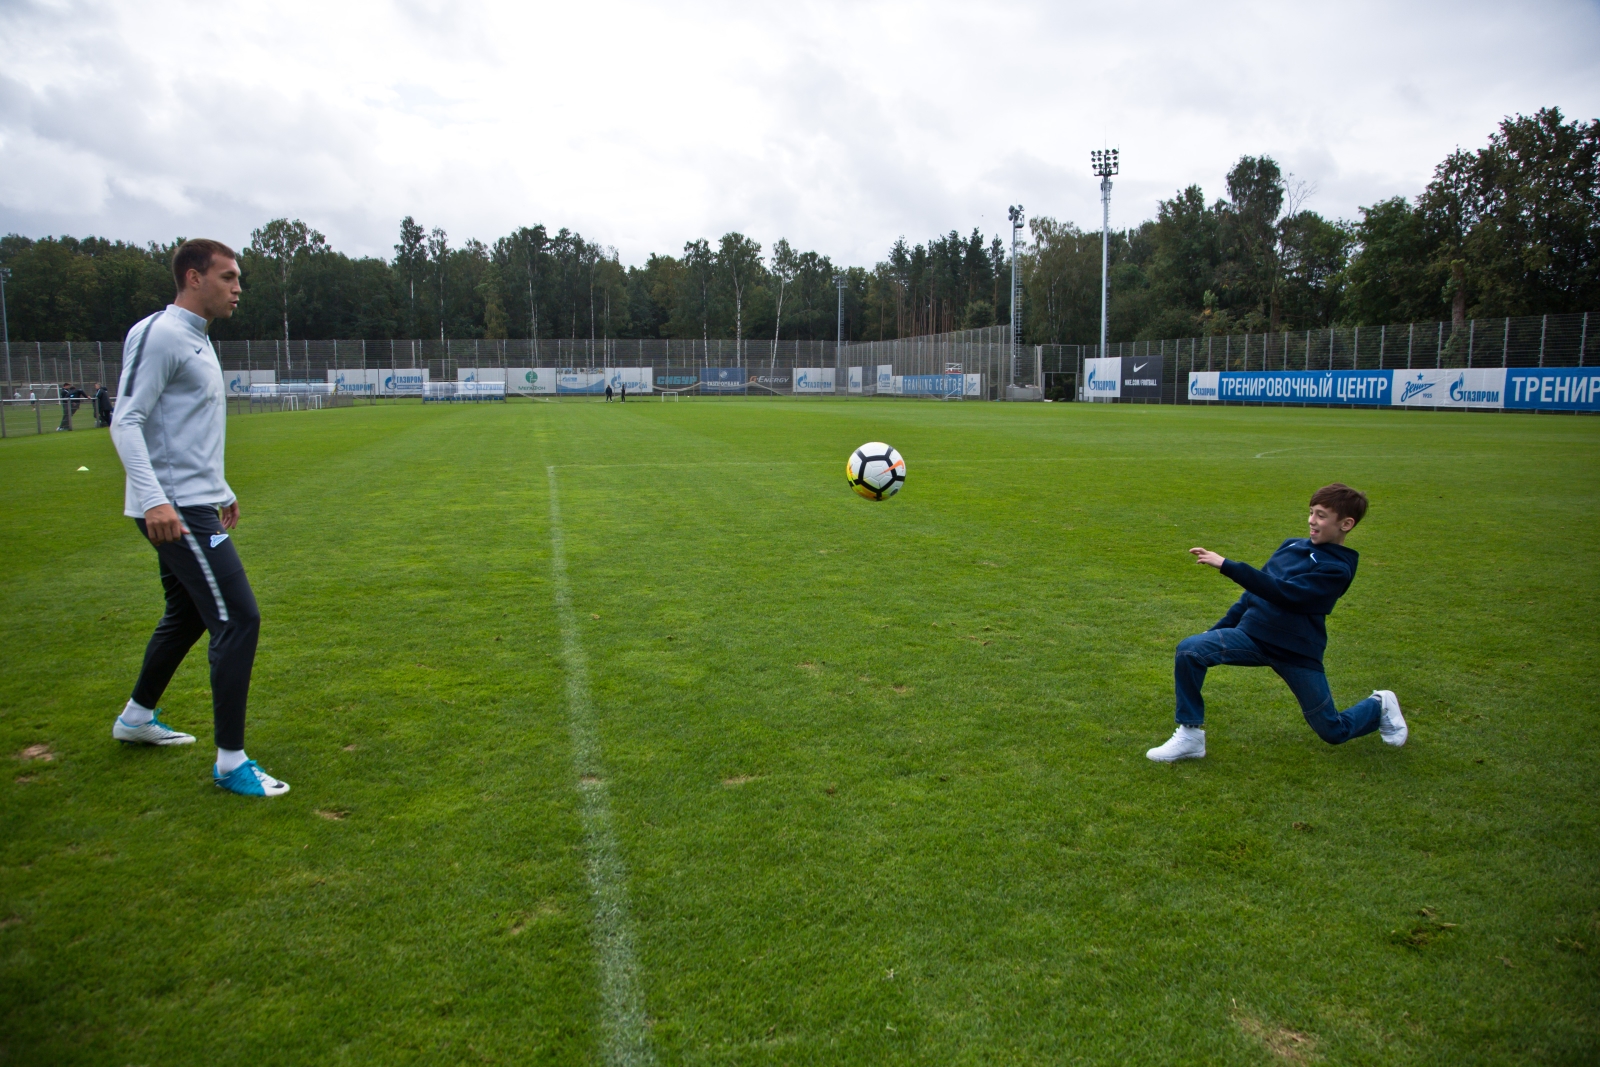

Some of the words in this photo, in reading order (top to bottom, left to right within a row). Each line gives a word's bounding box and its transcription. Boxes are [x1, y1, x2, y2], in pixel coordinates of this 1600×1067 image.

[657, 376, 697, 384] СИБУР
[904, 379, 932, 390] TRAINING
[1096, 380, 1116, 391] ГАЗПРОМ
[1221, 372, 1333, 398] ТРЕНИРОВОЧНЫЙ
[1336, 377, 1388, 401] ЦЕНТР
[1512, 376, 1600, 403] ТРЕНИР
[1463, 391, 1499, 402] ГАЗПРОМ
